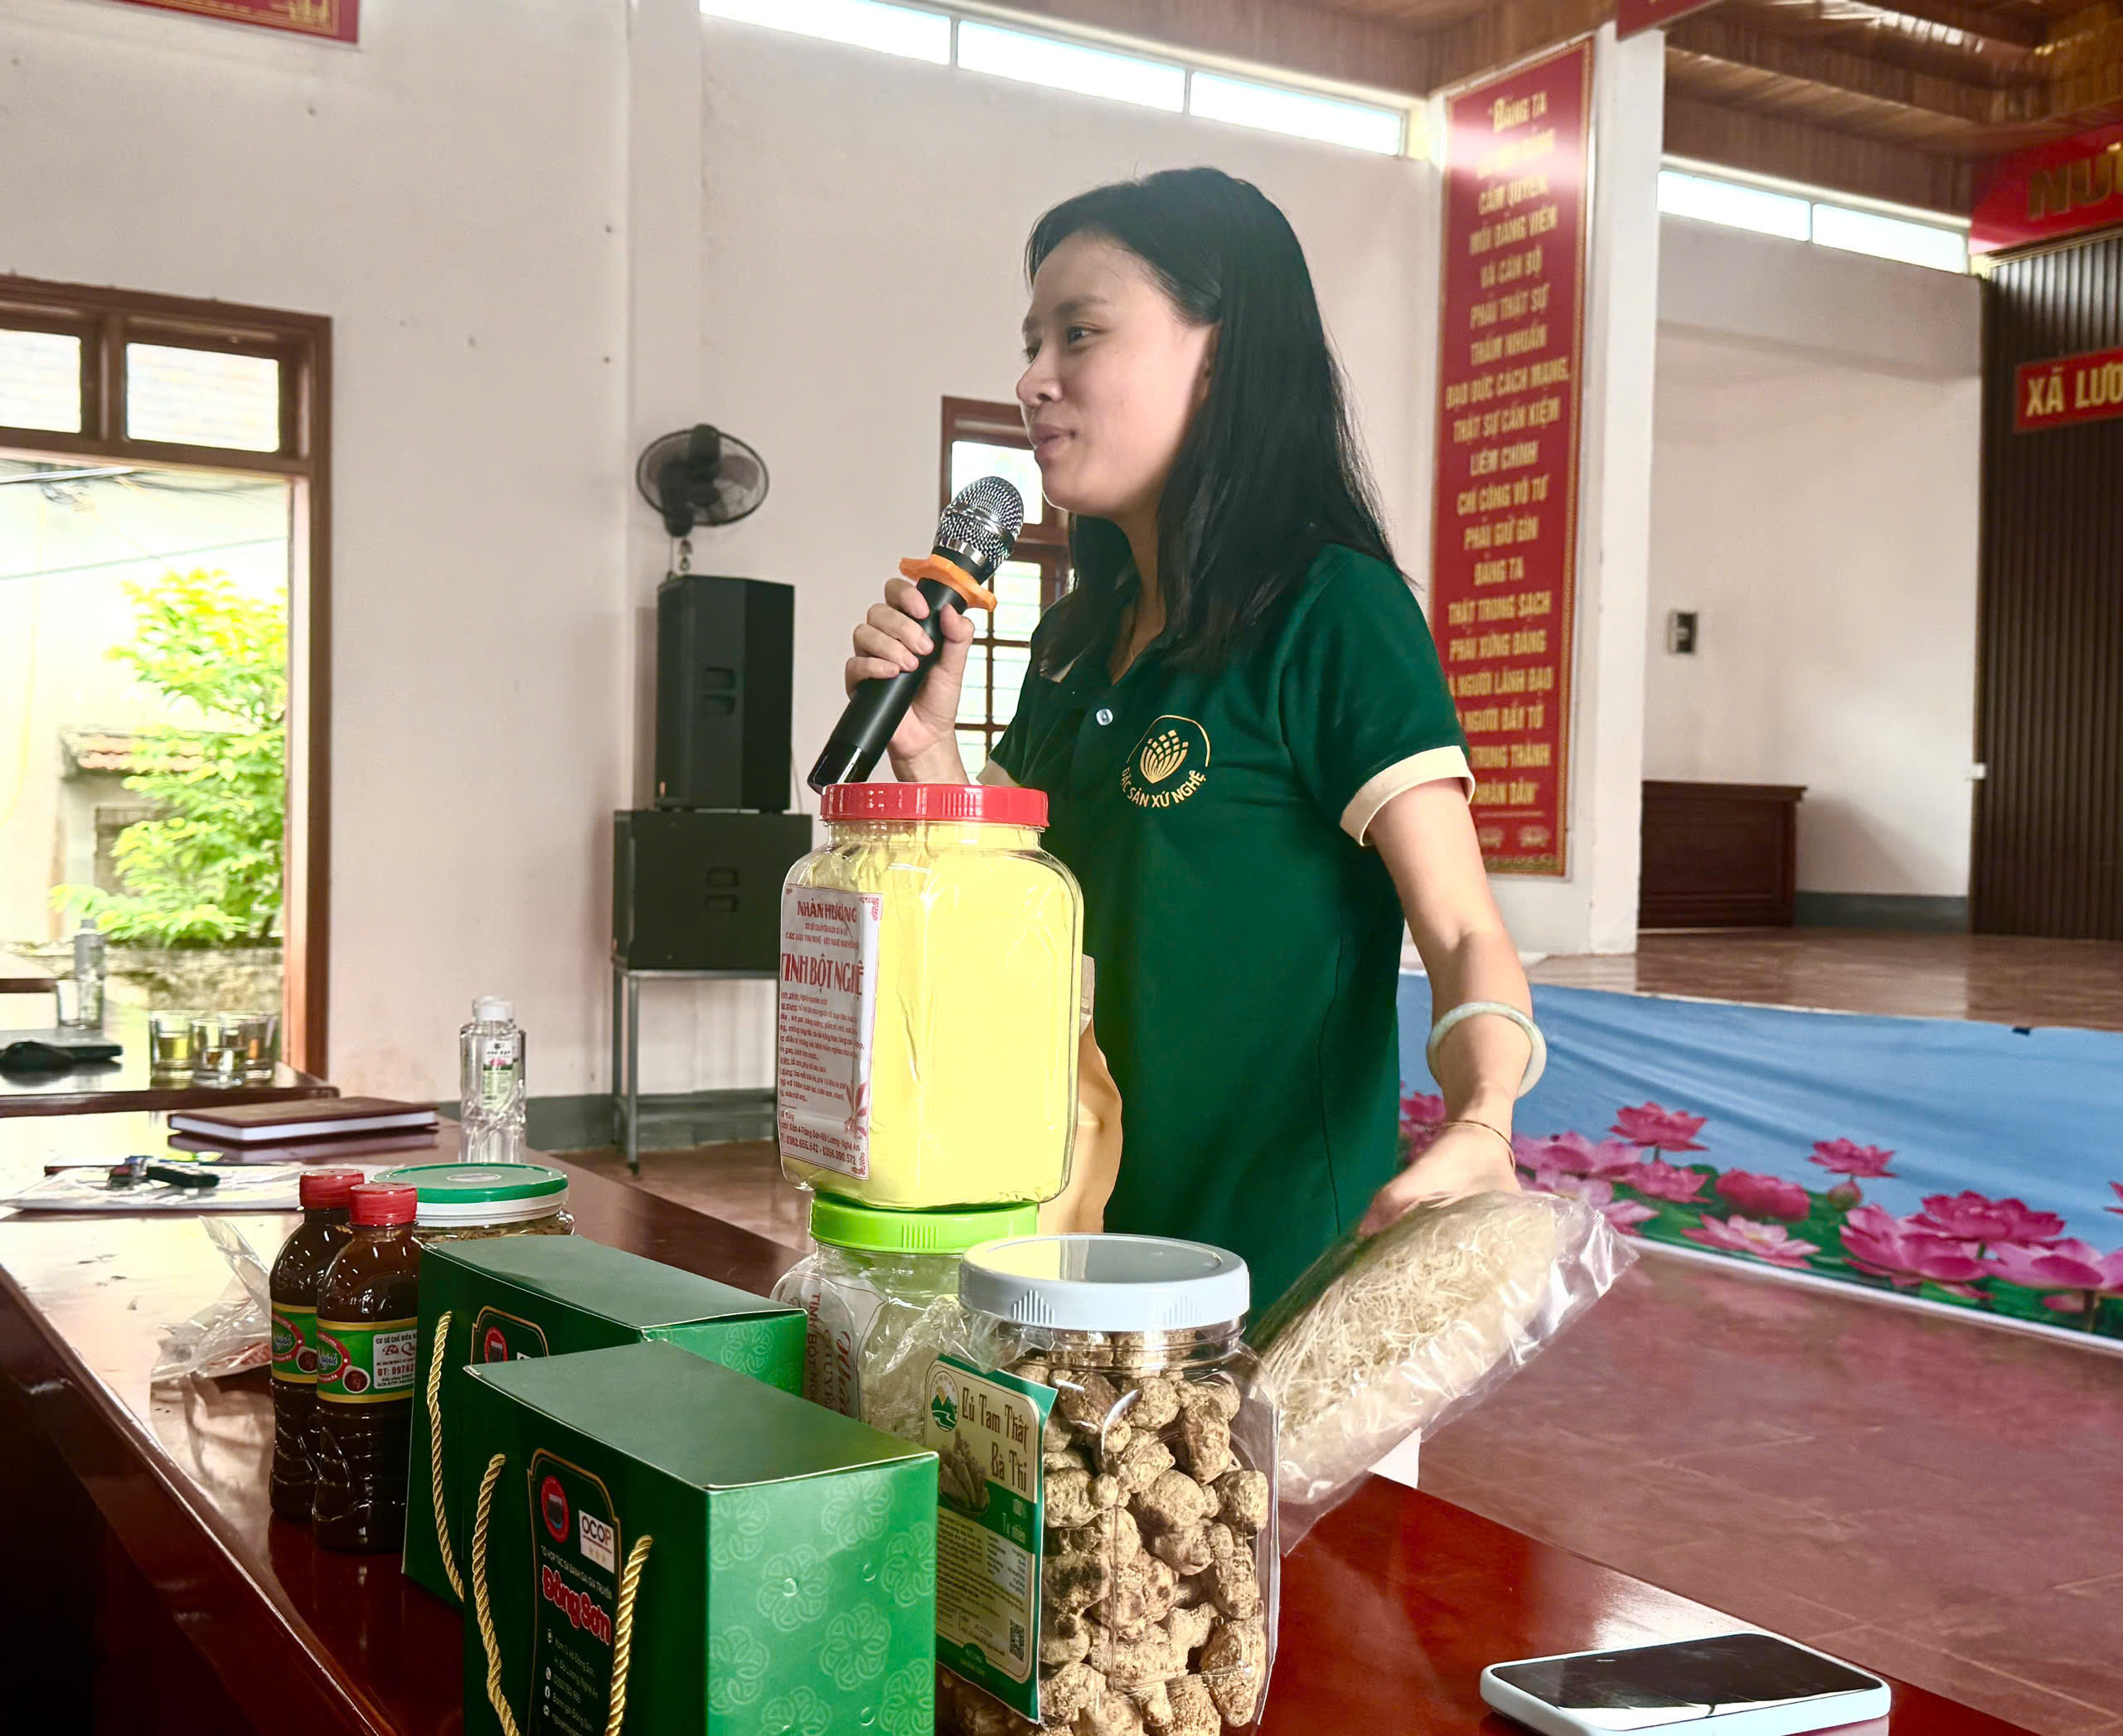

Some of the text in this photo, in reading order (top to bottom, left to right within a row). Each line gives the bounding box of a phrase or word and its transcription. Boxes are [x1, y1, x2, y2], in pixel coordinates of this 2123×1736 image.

[1497, 366, 1528, 397] CÁCH
[2026, 366, 2063, 417] XÃ
[1479, 482, 1511, 512] CÔNG
[1512, 475, 1529, 505] VÔ
[1474, 551, 1524, 587] ĐẢNG TA
[1477, 594, 1516, 623] TRONG
[1518, 590, 1552, 622] SẠCH
[1127, 788, 1150, 807] SẢN
[1151, 790, 1171, 808] XỨ
[1171, 769, 1207, 804] NGHỆ
[809, 953, 834, 993] BỘT
[808, 1292, 822, 1327] TINH
[979, 1393, 1001, 1433] Tam
[1005, 1404, 1029, 1453] Thất
[991, 1441, 1005, 1481] Bà
[581, 1514, 612, 1546] OCOP
